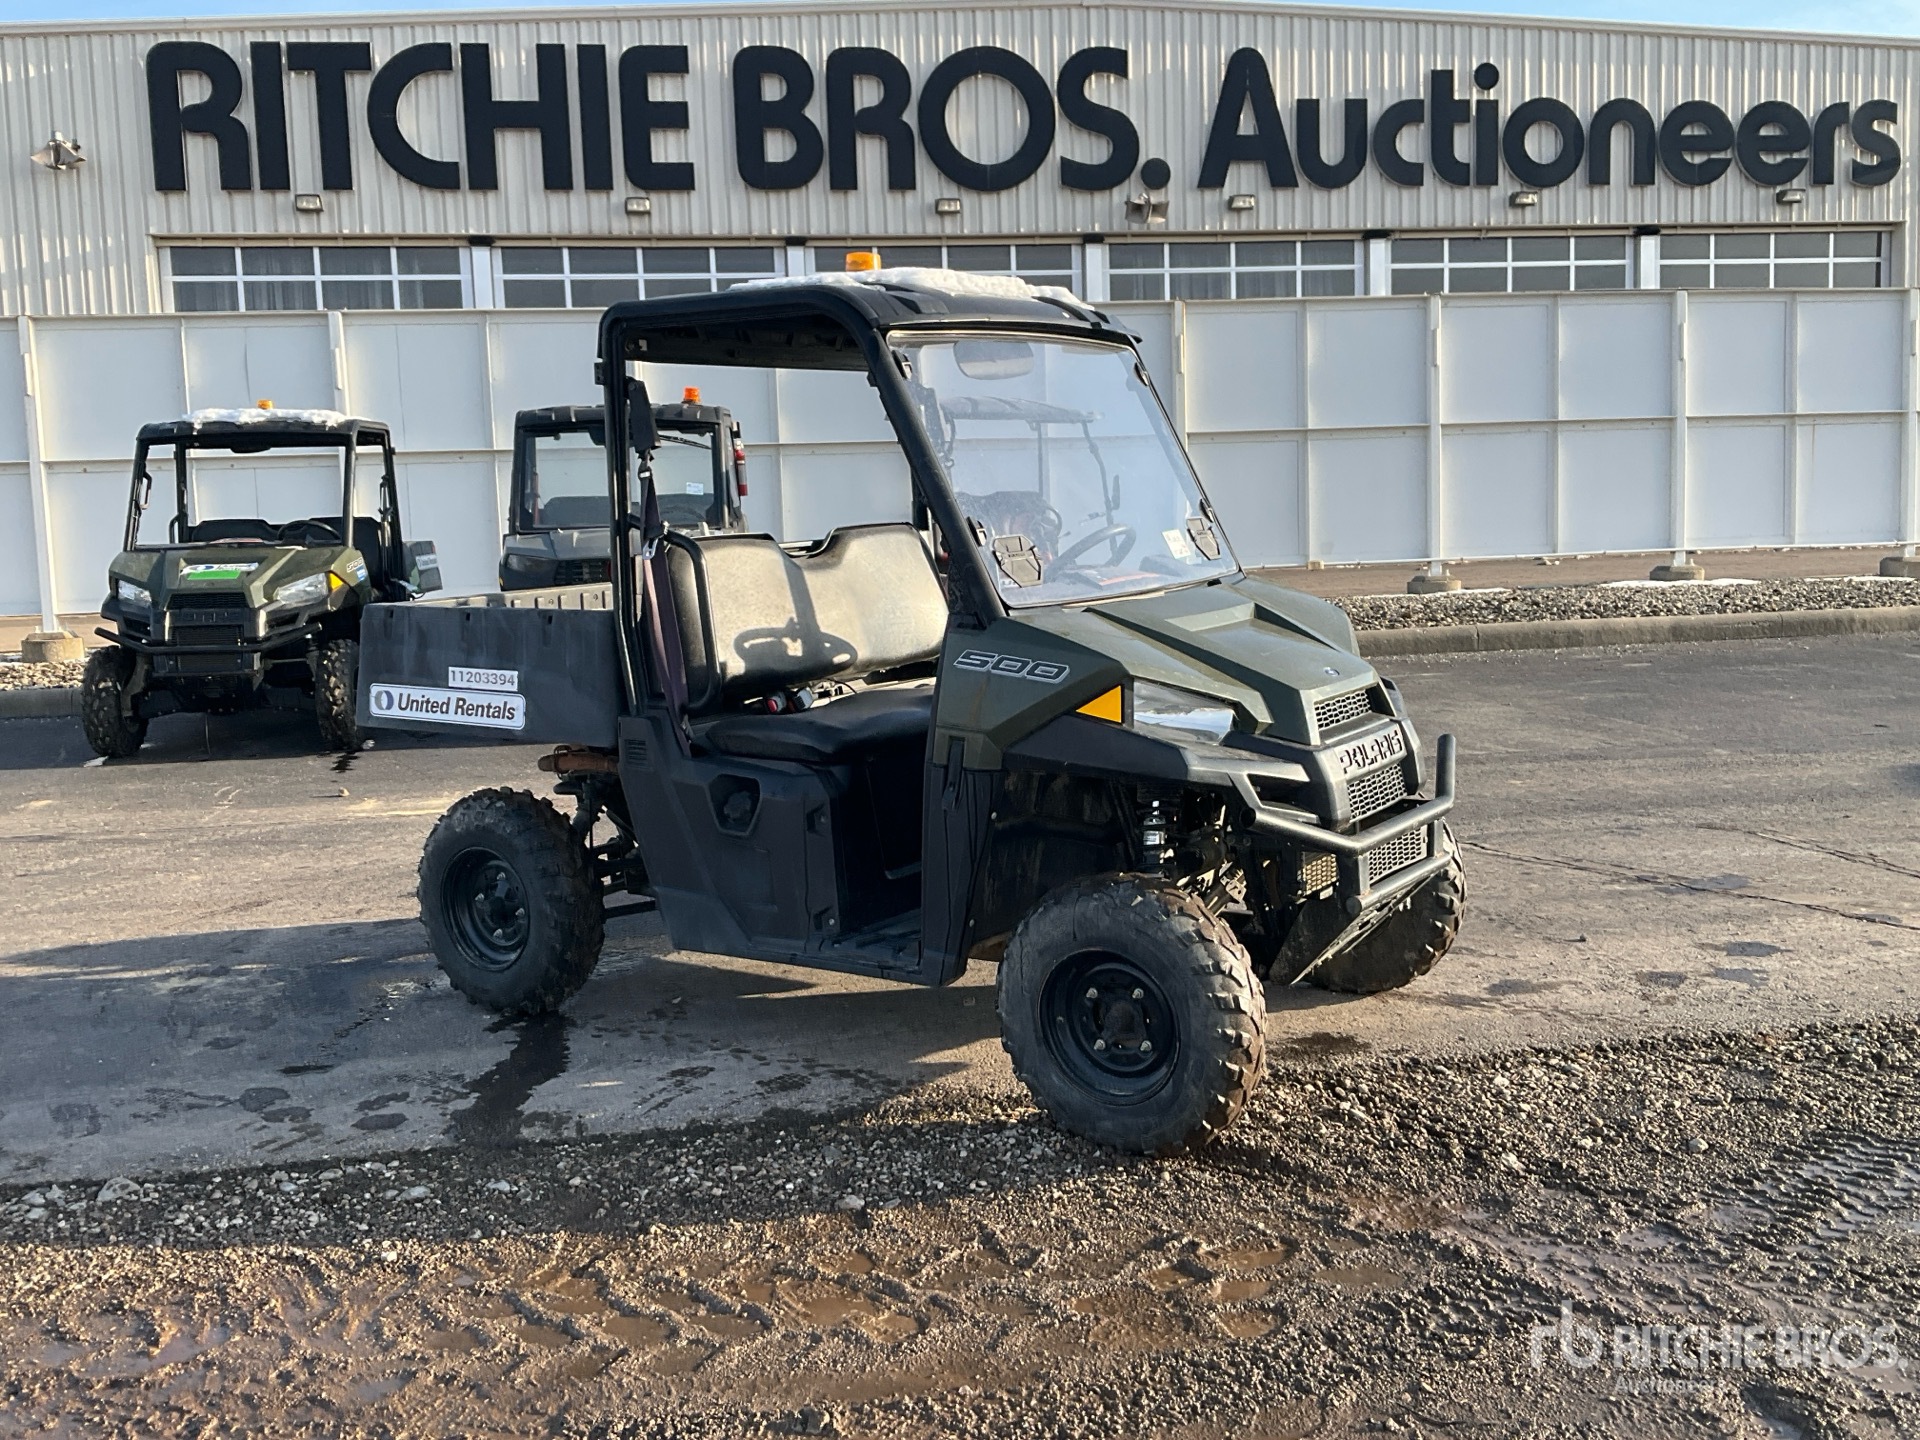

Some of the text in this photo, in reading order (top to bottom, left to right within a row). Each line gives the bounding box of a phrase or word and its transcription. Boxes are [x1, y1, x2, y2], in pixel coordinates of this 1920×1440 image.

[146, 41, 1901, 192] RITCHIE BROS. Auctioneers
[451, 670, 516, 686] 11203394
[953, 649, 1070, 684] 500
[397, 693, 516, 720] United Rentals
[1340, 729, 1403, 775] POLARIS
